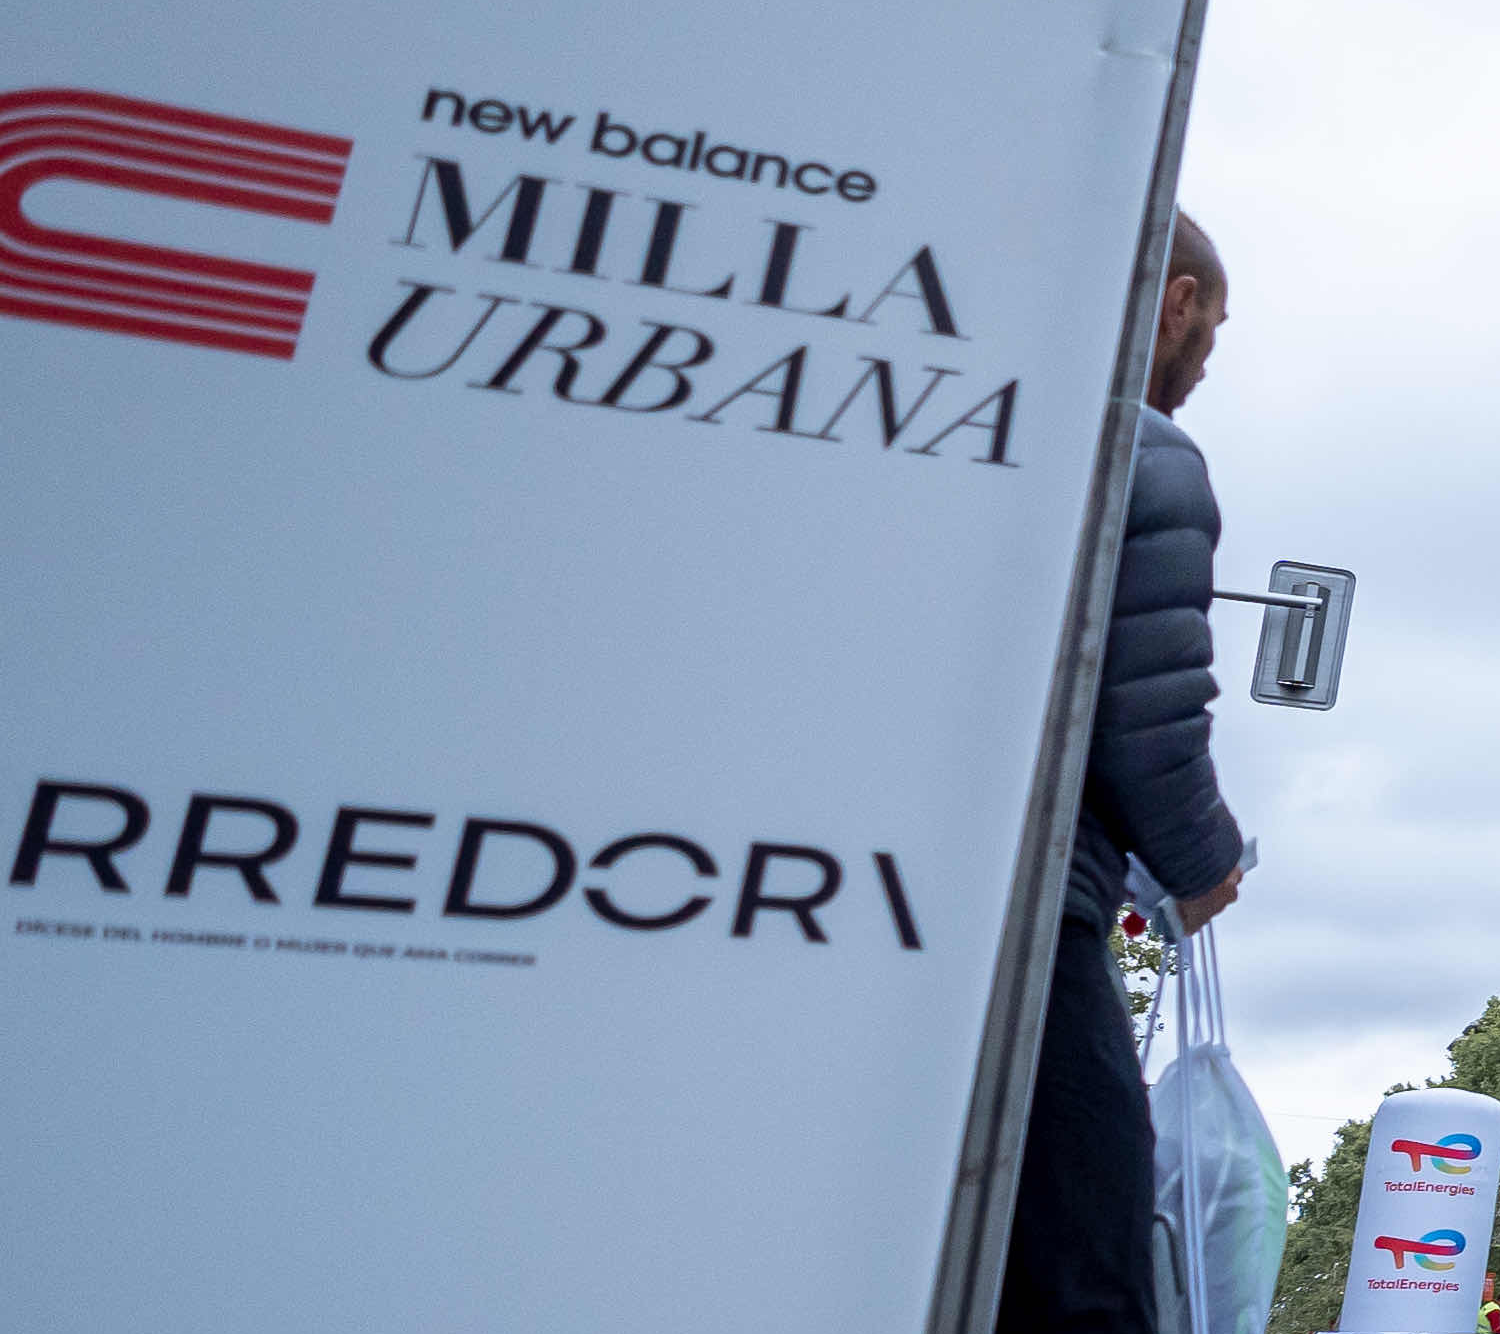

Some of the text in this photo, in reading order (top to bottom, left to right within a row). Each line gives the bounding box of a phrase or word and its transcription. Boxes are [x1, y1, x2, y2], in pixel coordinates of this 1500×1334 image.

[420, 86, 878, 204] new balance
[390, 155, 972, 342] MILLA
[365, 279, 1021, 469] URBANA
[1384, 1181, 1475, 1197] TotalEnergies
[1367, 1278, 1460, 1293] TotalEnergies
